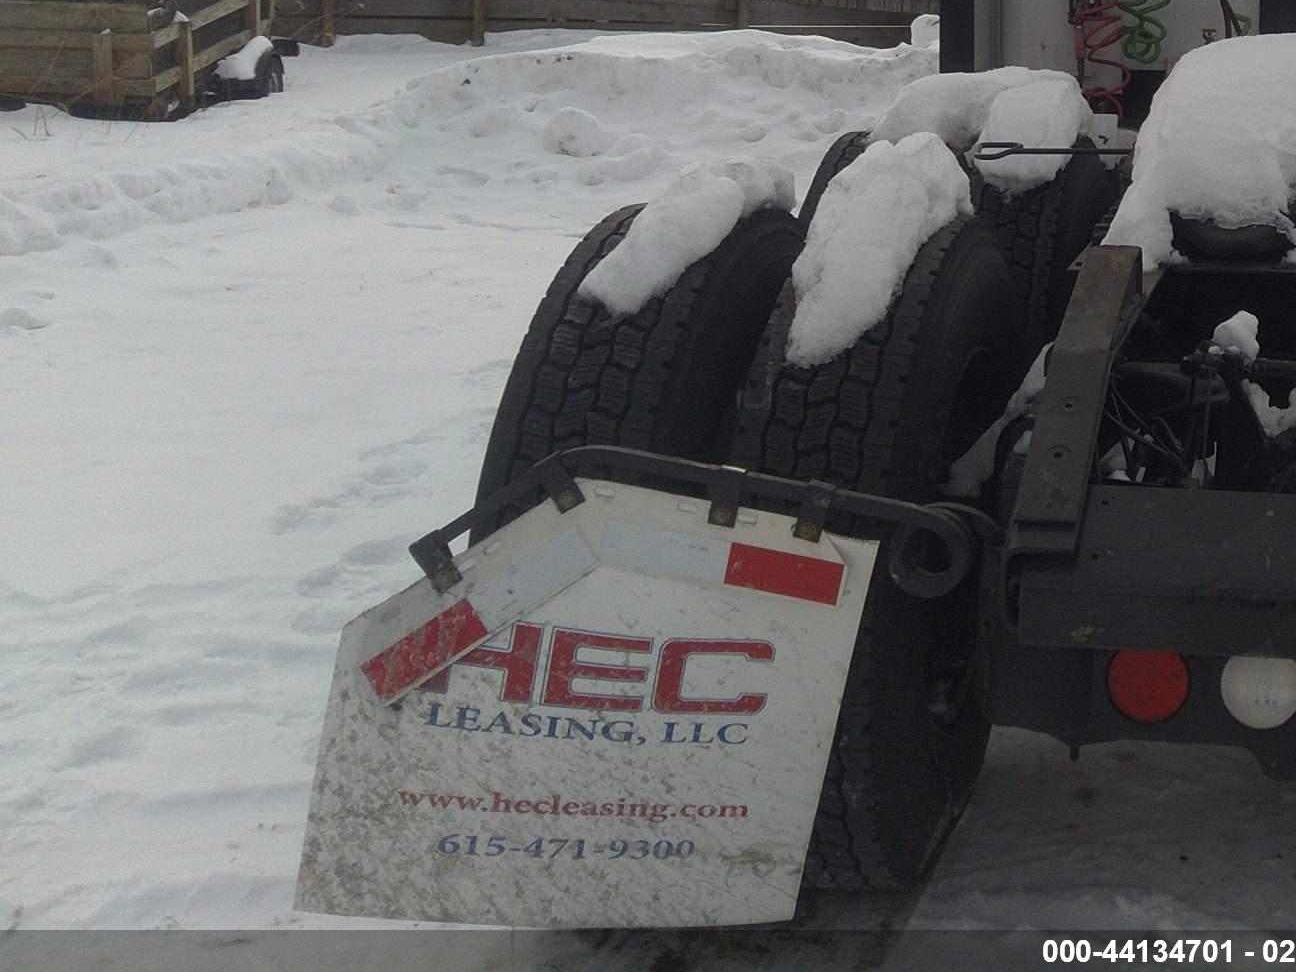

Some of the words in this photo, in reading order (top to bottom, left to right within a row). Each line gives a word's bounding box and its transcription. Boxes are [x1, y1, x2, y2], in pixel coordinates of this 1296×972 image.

[416, 620, 776, 716] HEC
[424, 702, 648, 746] LEASING,
[659, 721, 749, 745] LLC
[398, 790, 750, 822] www.hecleasing.com
[437, 833, 697, 860] 615-471-9300
